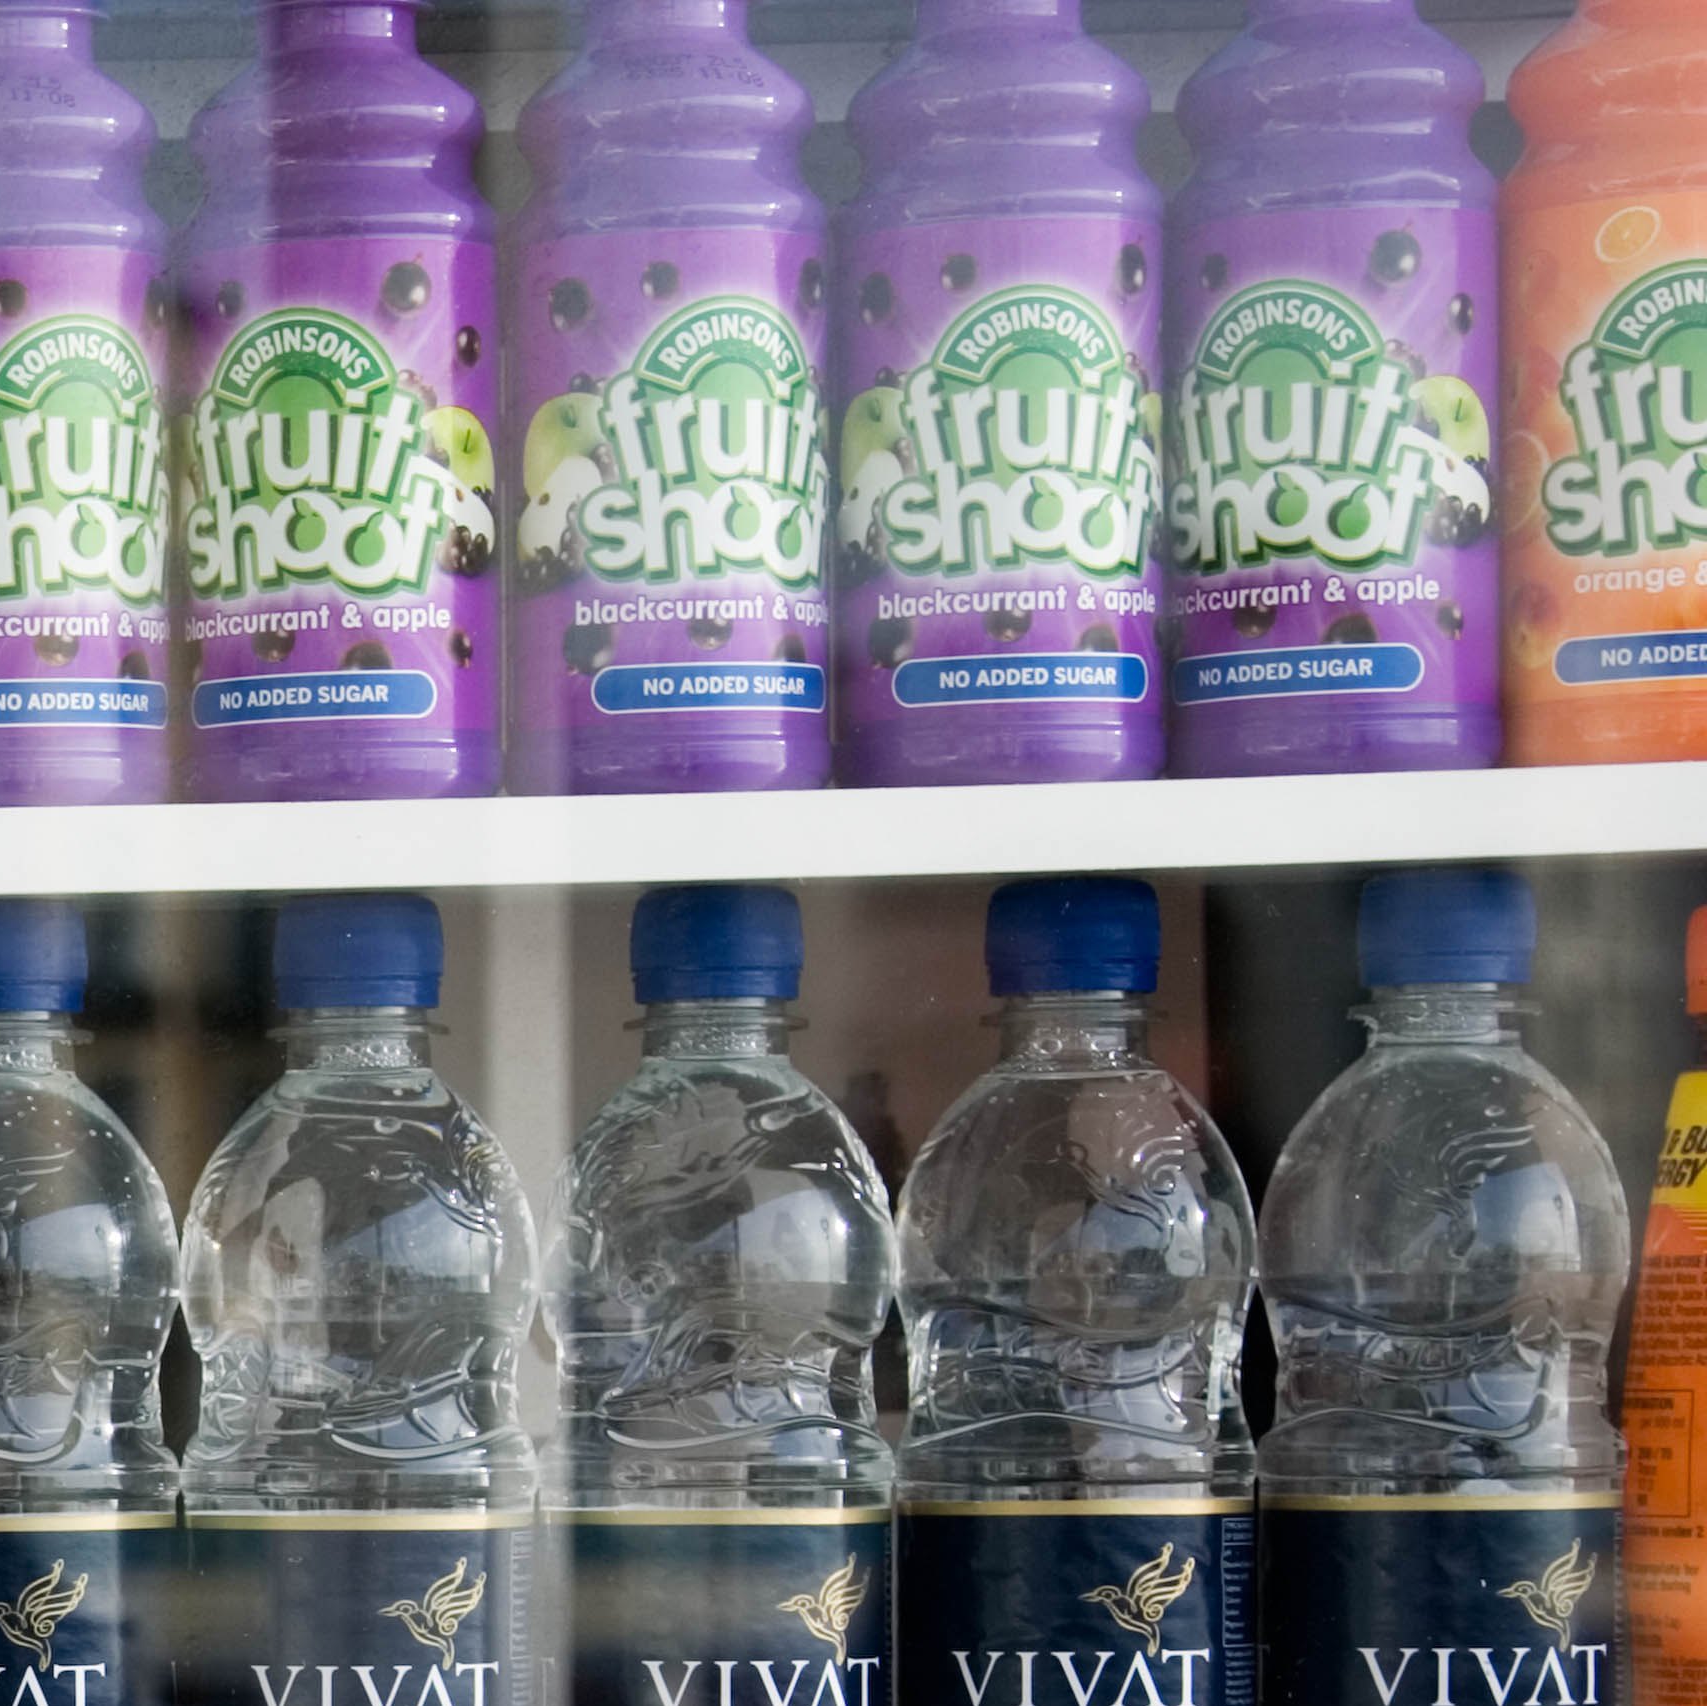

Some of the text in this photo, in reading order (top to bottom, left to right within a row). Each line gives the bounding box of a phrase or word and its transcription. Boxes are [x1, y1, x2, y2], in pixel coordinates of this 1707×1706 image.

[230, 327, 370, 388] ROBINSONS
[957, 304, 1105, 363] ROBINSONS
[199, 390, 414, 491] fruit
[909, 370, 1135, 474] fruit
[188, 480, 439, 587] shoot
[887, 462, 1150, 572] shoot
[880, 582, 1156, 619] blackcurrant & apple
[1575, 565, 1686, 594] orange
[342, 604, 362, 628] &
[374, 602, 451, 632] apple
[220, 685, 389, 710] NO ADDED SUGAR
[940, 667, 1116, 688] NO ADDED SUGAR
